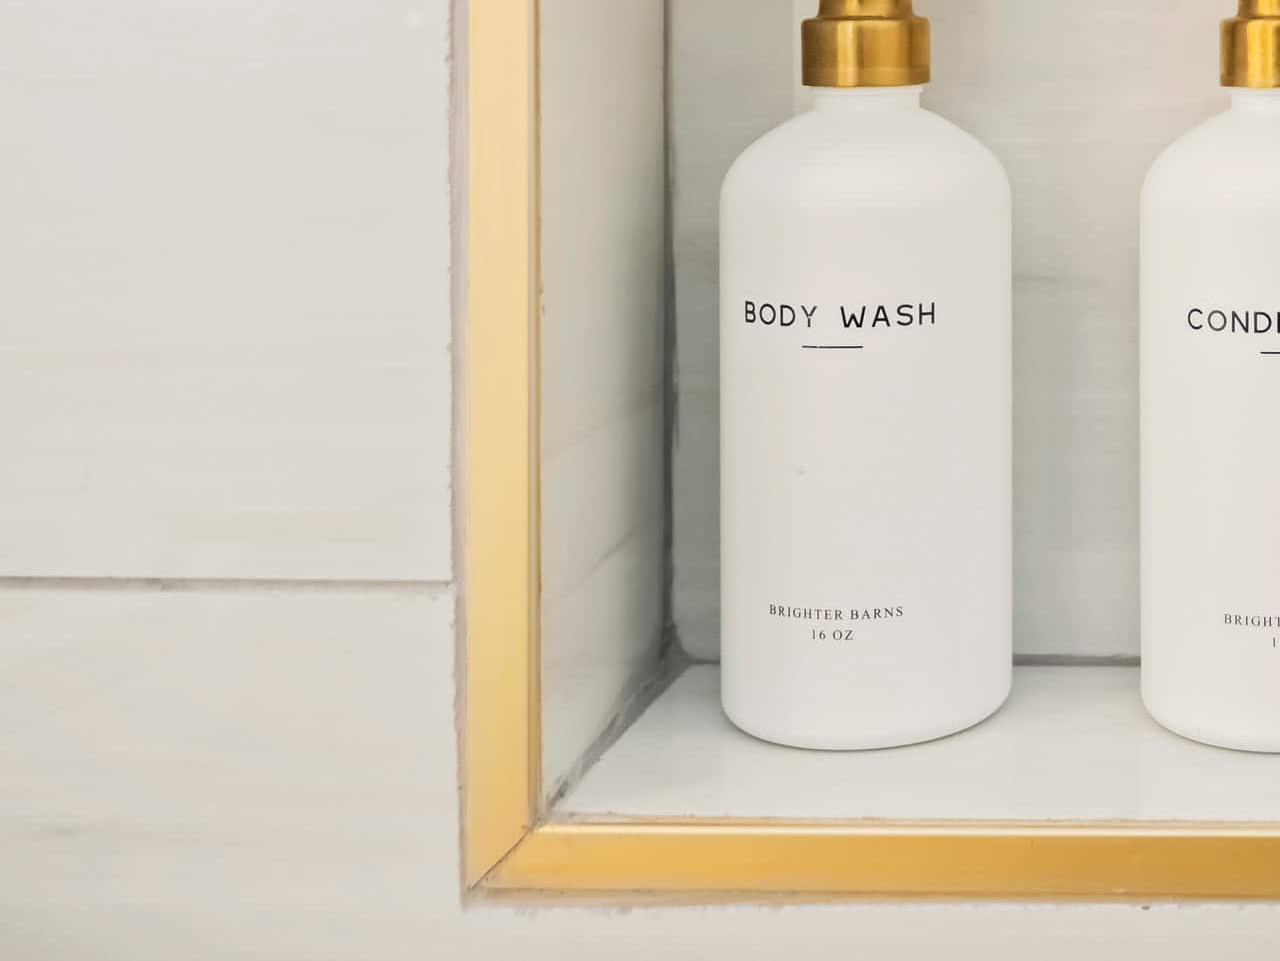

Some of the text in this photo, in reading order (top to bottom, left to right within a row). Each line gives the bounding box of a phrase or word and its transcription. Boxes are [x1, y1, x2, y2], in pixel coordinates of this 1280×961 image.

[744, 299, 936, 329] BODY WASH
[769, 603, 904, 621] BRIGHTER BARNS
[811, 628, 854, 641] 16 OZ
